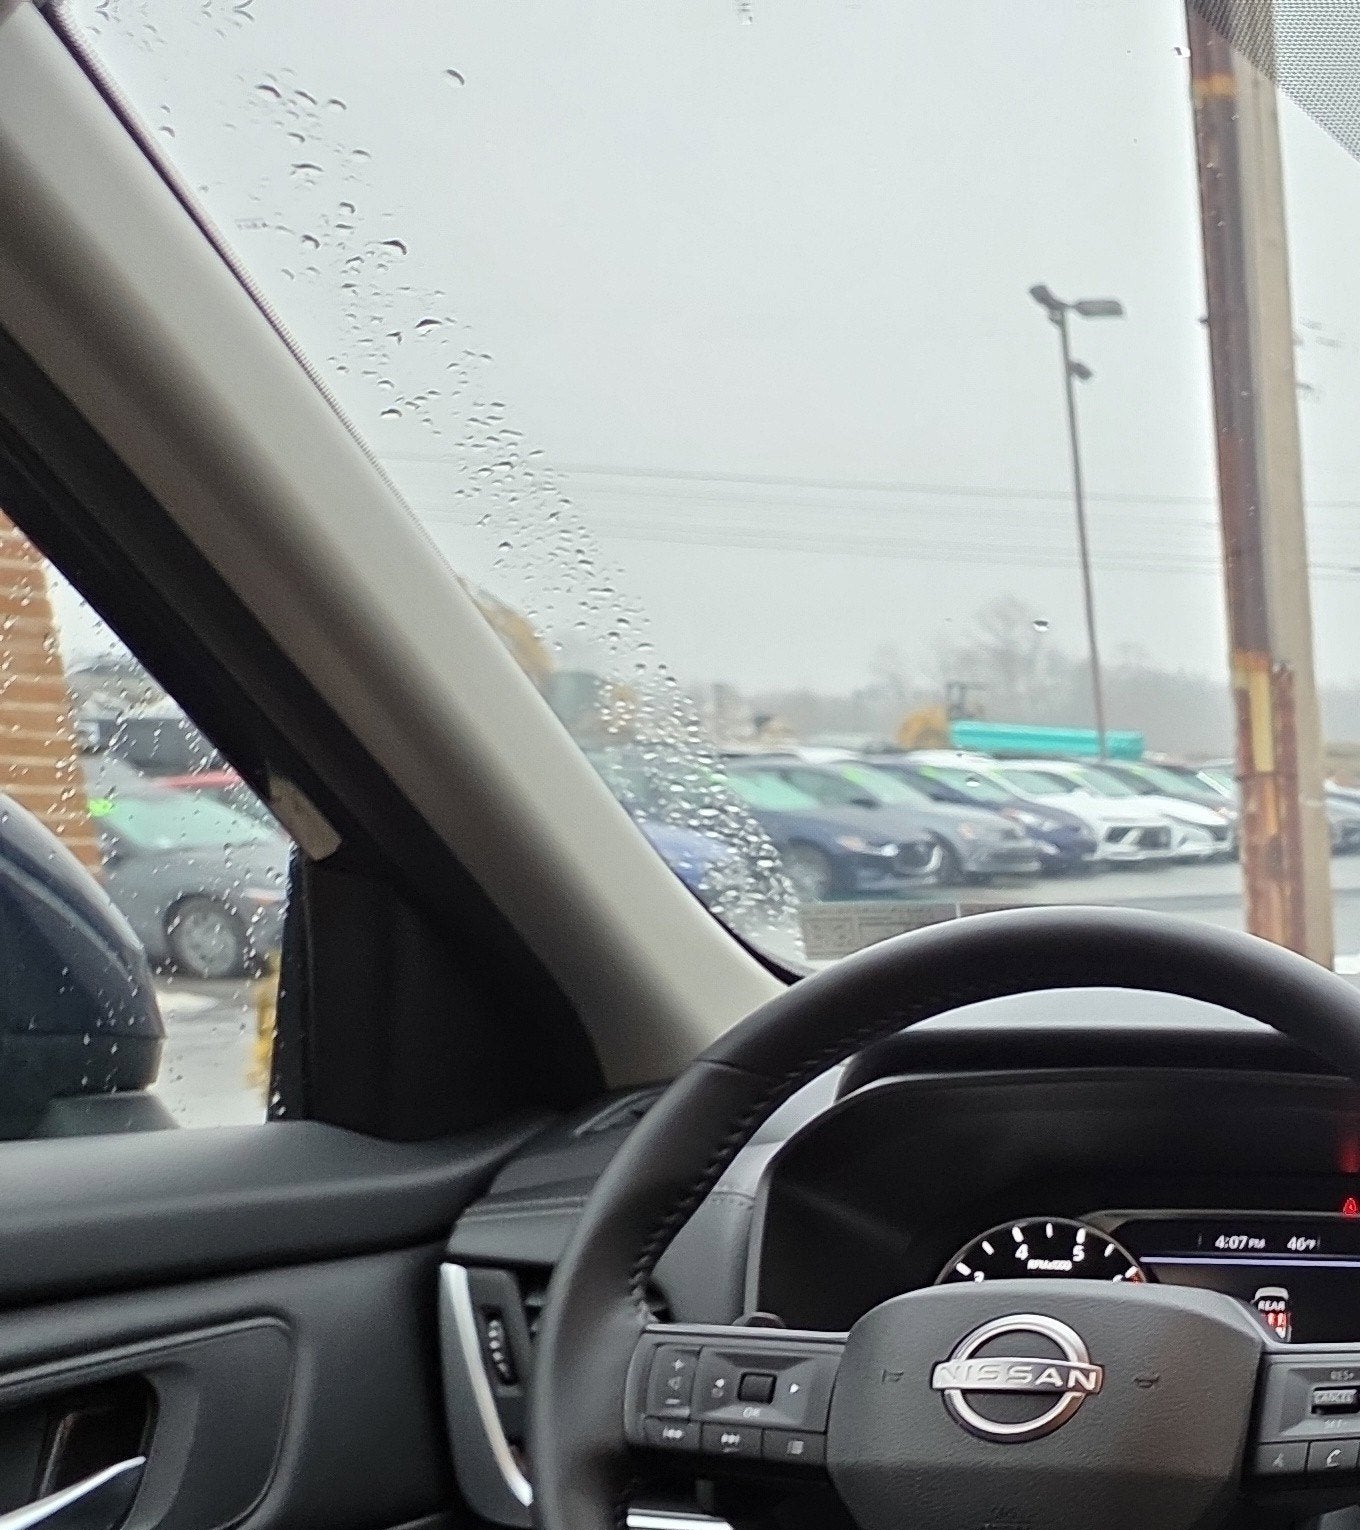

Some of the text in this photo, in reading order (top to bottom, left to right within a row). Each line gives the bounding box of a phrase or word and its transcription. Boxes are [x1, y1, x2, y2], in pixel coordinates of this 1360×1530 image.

[1214, 1234, 1249, 1250] 4:07
[1014, 1243, 1029, 1261] 4
[1072, 1244, 1086, 1262] 5
[939, 1362, 1097, 1392] NISSAN
